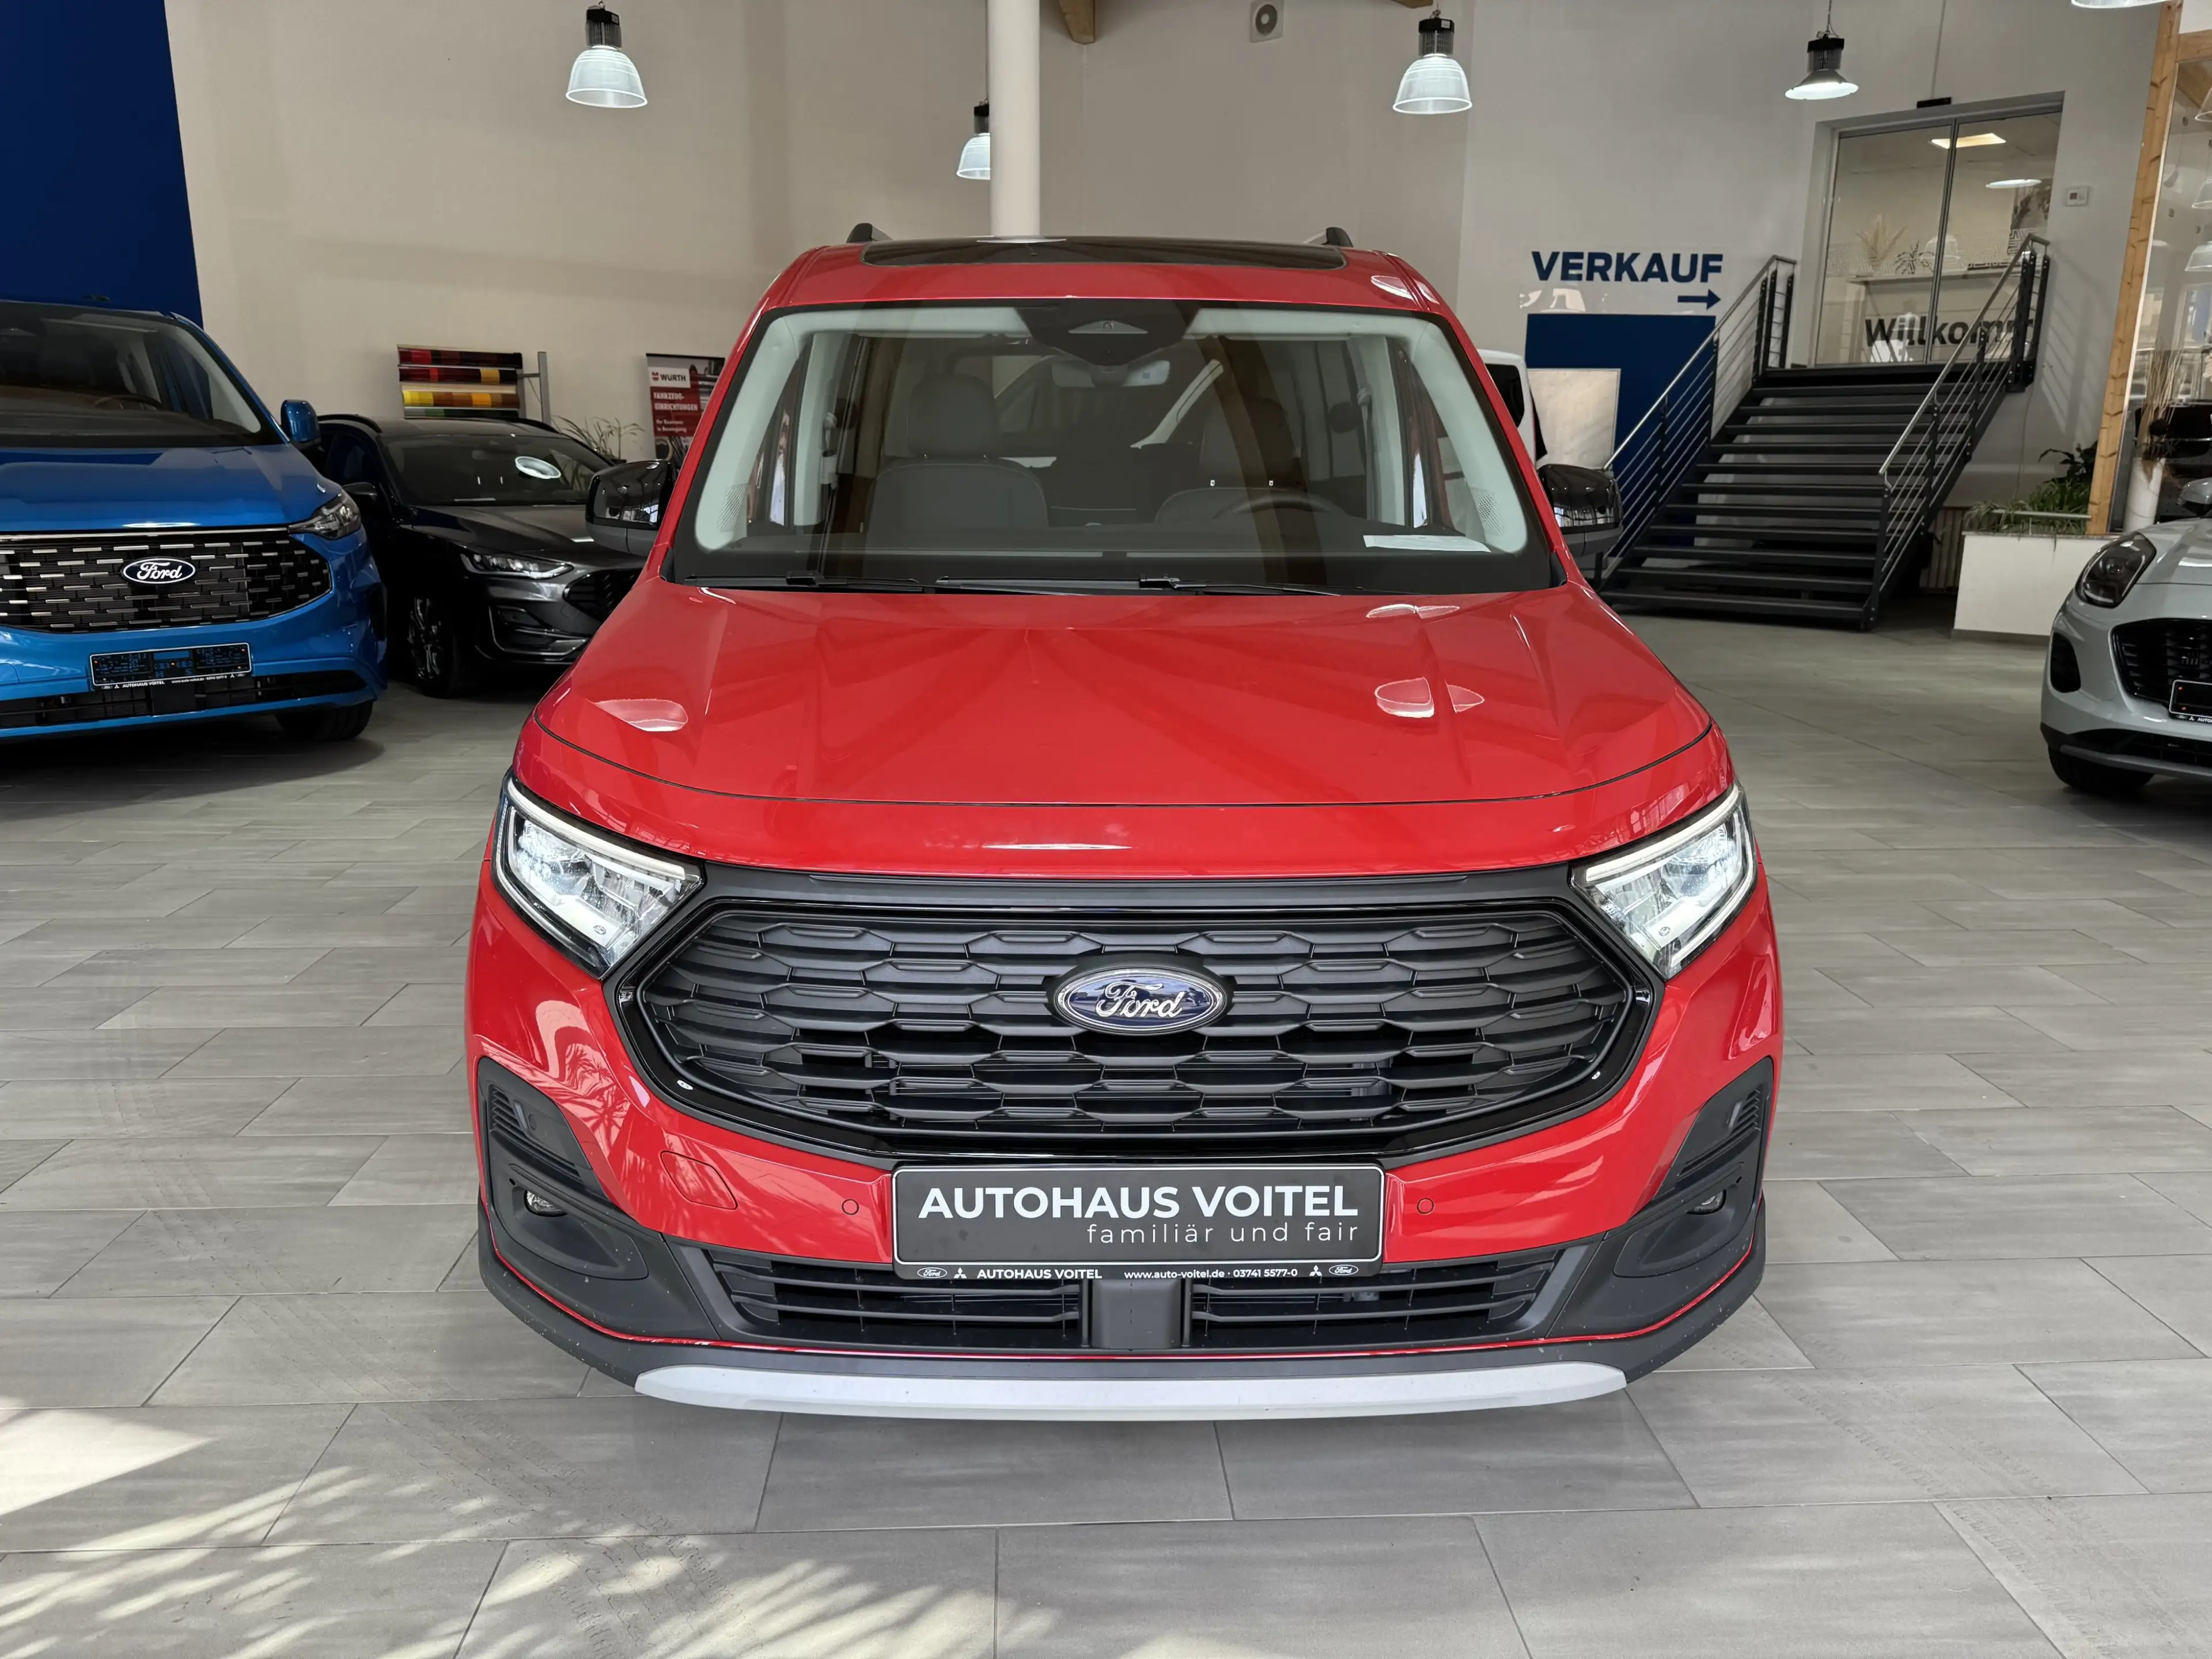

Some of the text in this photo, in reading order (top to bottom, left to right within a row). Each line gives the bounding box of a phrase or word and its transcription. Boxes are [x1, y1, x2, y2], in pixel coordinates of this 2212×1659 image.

[1532, 252, 1723, 282] VERKAUF
[137, 562, 183, 580] Ford
[1096, 980, 1187, 1018] Ford
[918, 1185, 1358, 1218] AUTOHAUS VOITEL
[1087, 1222, 1357, 1243] familiär und fair
[977, 1269, 1051, 1279] AUTOHAUS
[1055, 1268, 1103, 1279] VOITEL
[1124, 1269, 1225, 1279] www.auto-voitel.de
[1233, 1269, 1260, 1277] 03741
